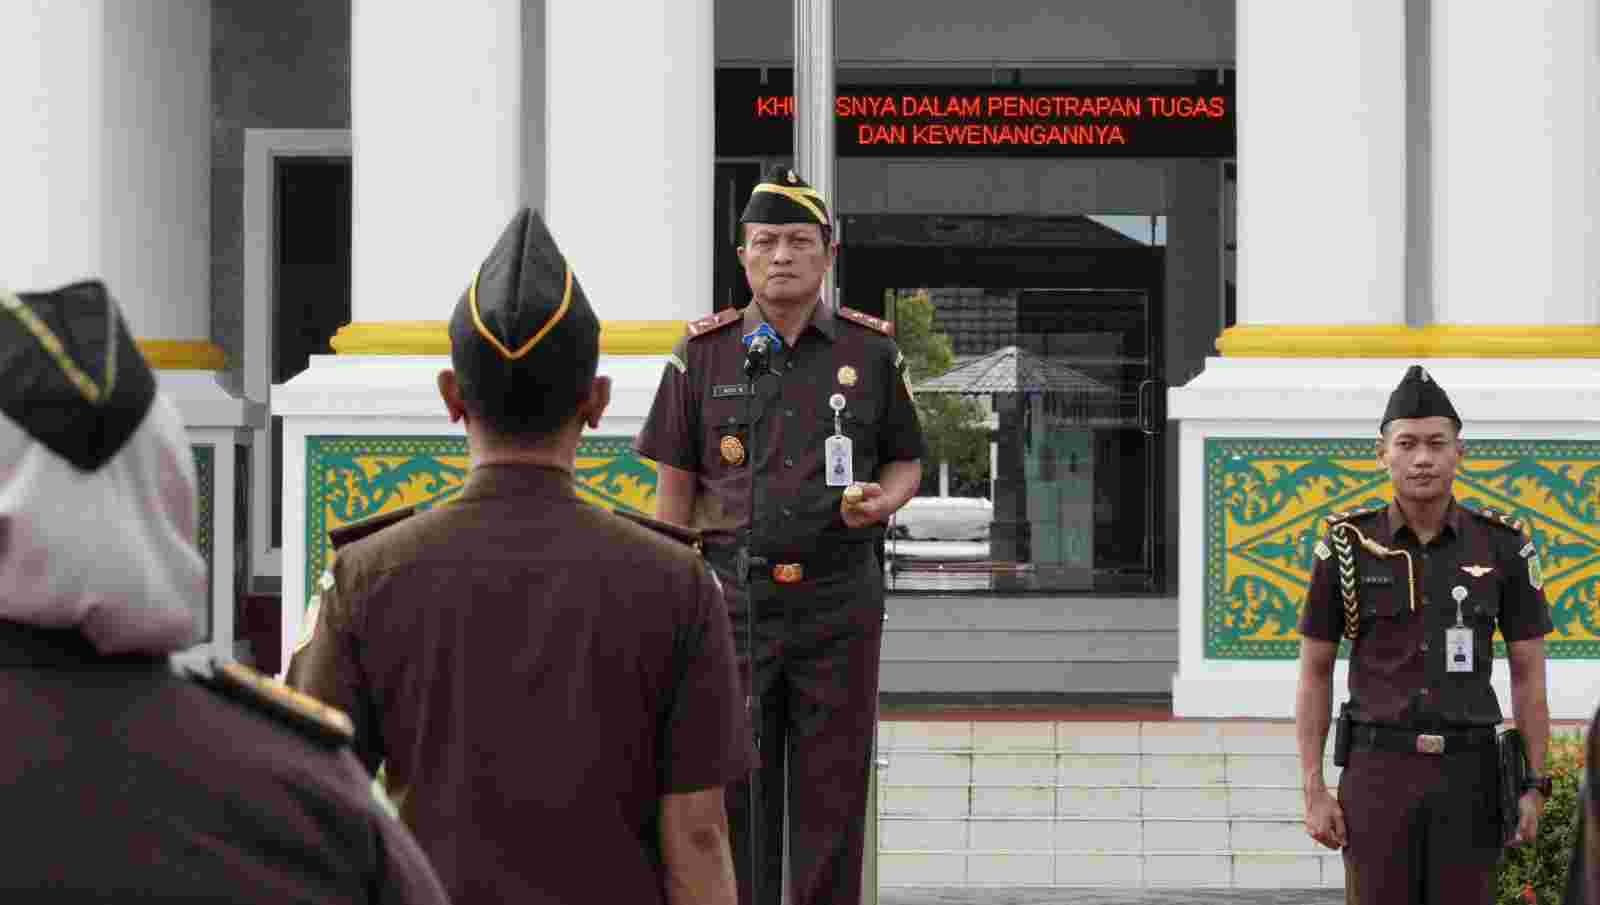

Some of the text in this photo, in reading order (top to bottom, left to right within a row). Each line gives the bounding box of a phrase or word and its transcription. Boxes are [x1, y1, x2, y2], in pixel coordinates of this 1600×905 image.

[757, 96, 1225, 117] KHSNYA DALAM PENGTRAPAN TUGAS
[858, 124, 1126, 144] DAN KEWENANGANNYA
